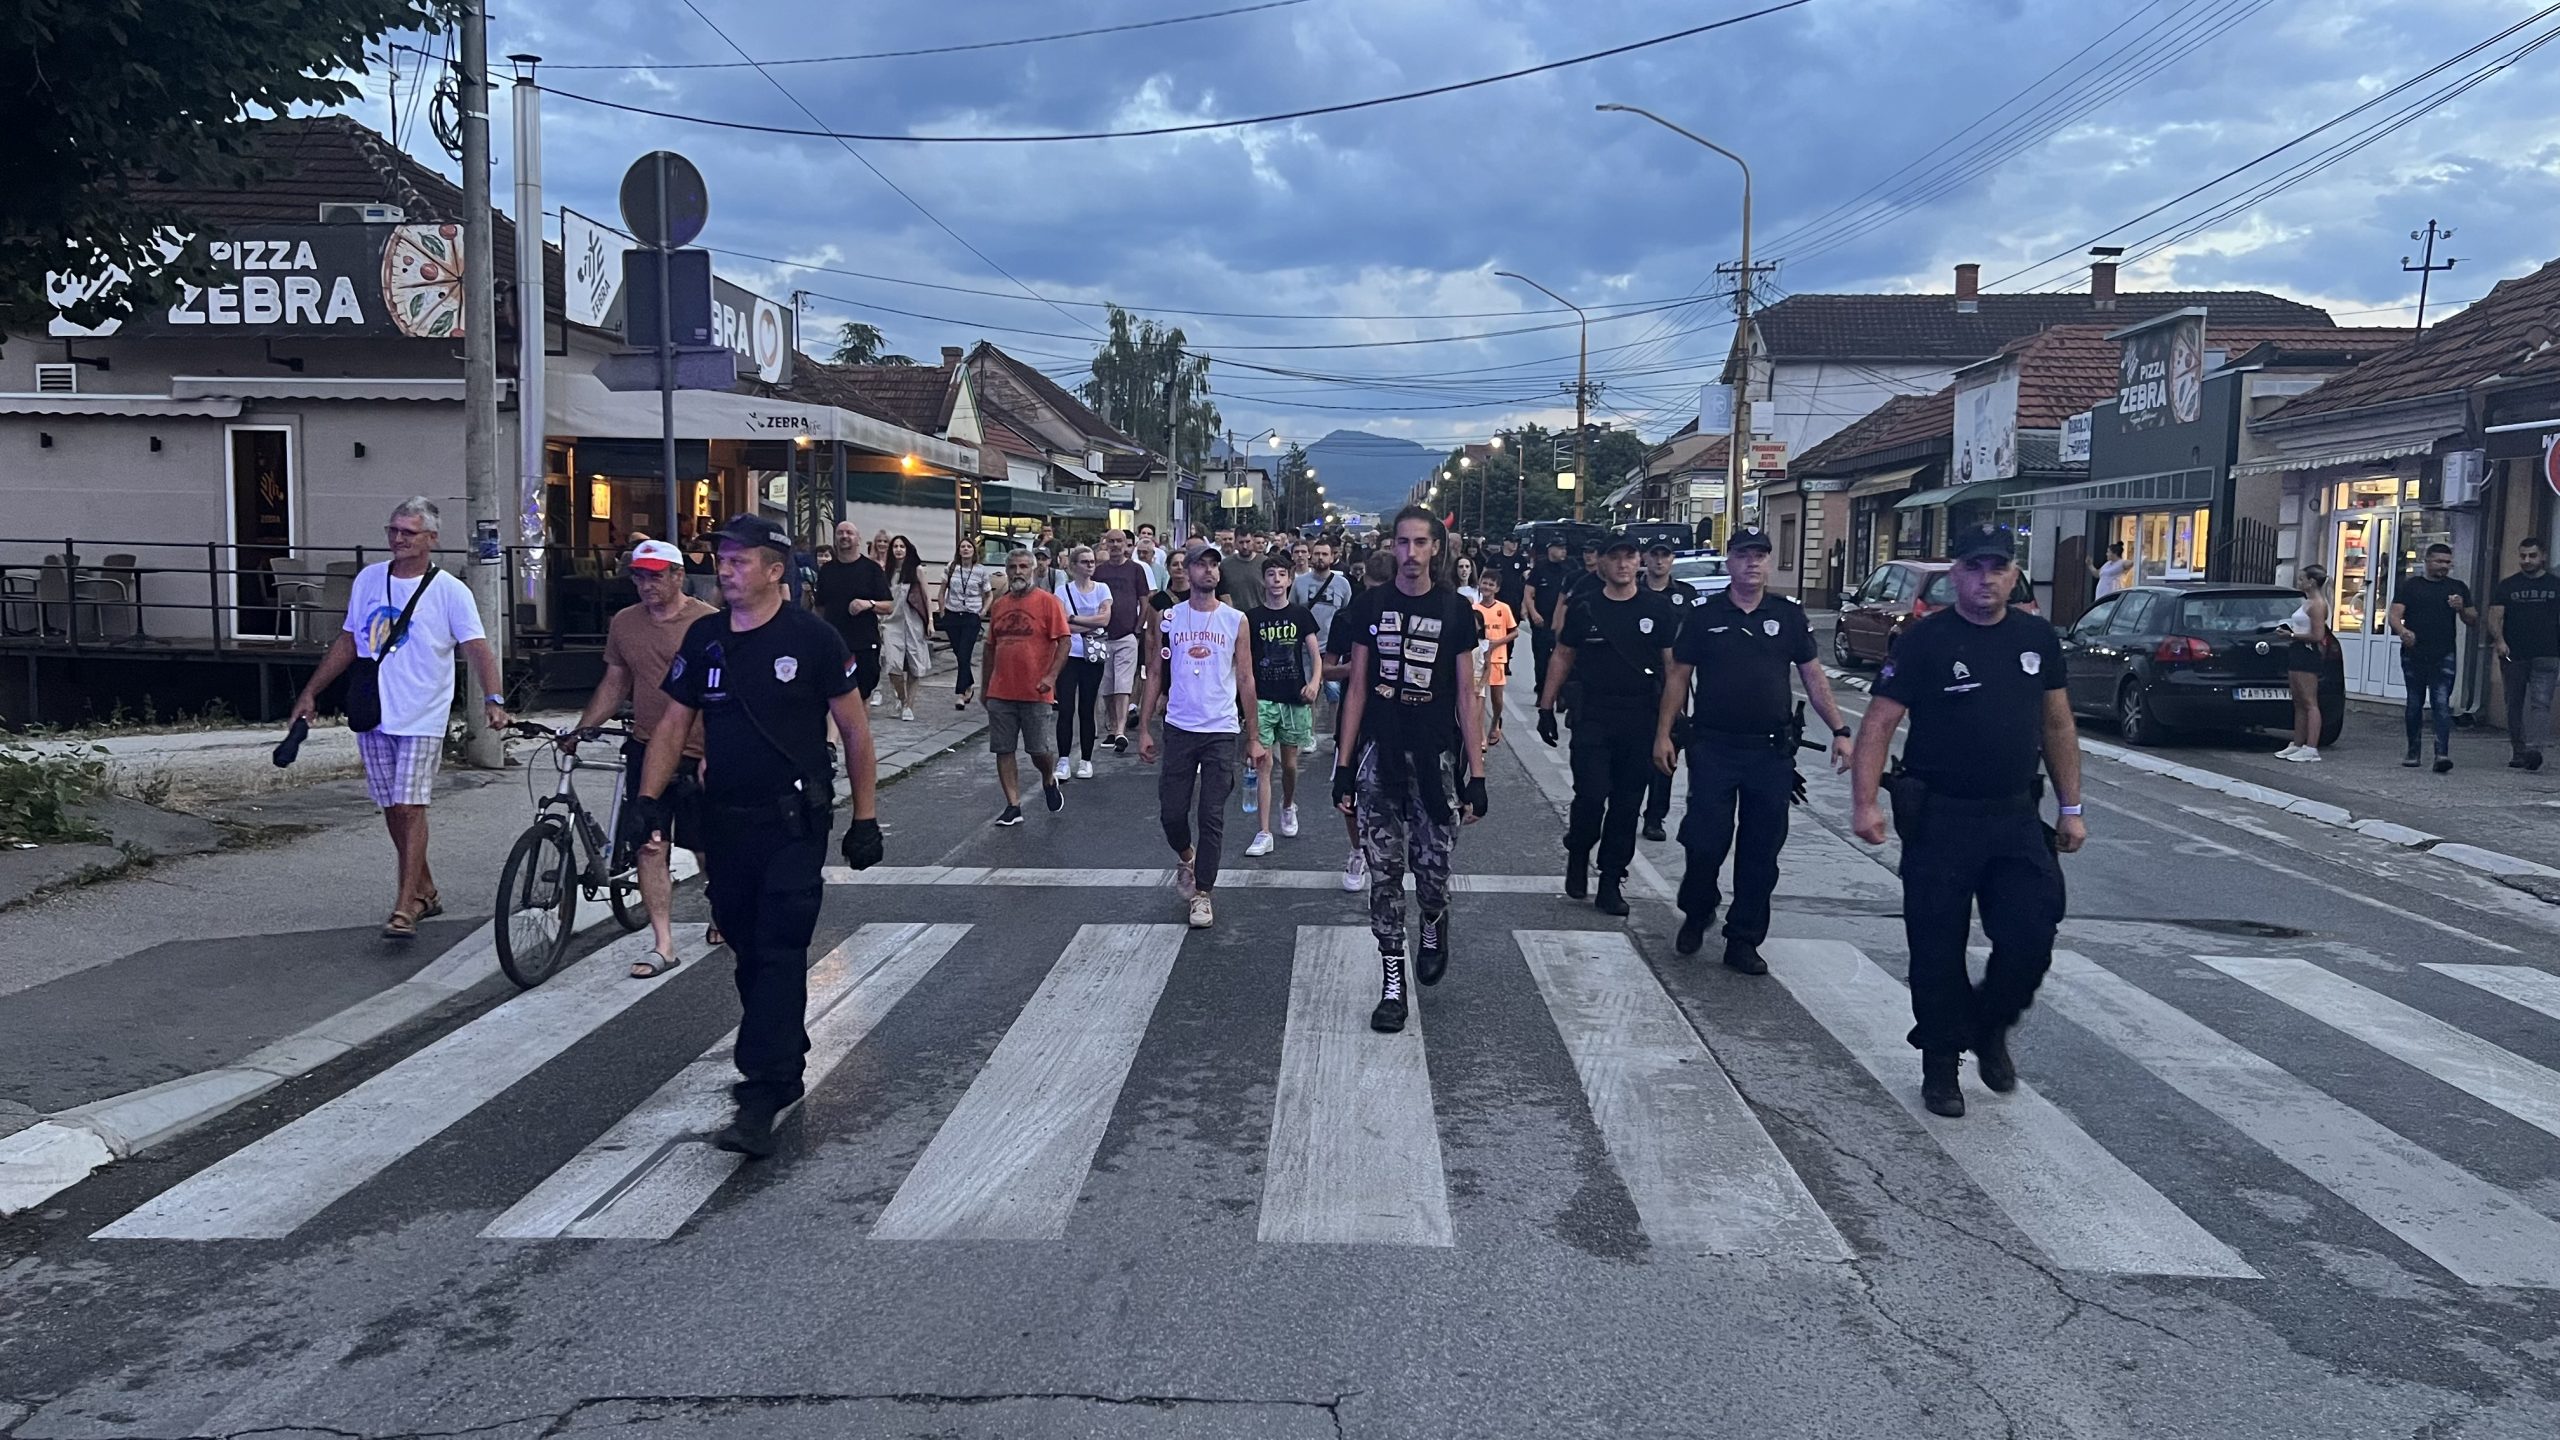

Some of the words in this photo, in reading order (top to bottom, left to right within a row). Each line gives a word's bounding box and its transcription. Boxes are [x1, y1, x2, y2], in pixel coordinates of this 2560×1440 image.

[210, 241, 317, 270] PIZZA
[168, 276, 365, 324] ZEBRA
[591, 279, 611, 320] ZEBRA
[713, 300, 750, 357] BRA
[2140, 359, 2166, 381] PIZZA
[2119, 379, 2167, 415] ZEBRA
[767, 416, 809, 428] ZEBRA
[1173, 631, 1226, 648] CALIFORNIA
[2241, 689, 2253, 698] CA
[2262, 688, 2279, 698] 151
